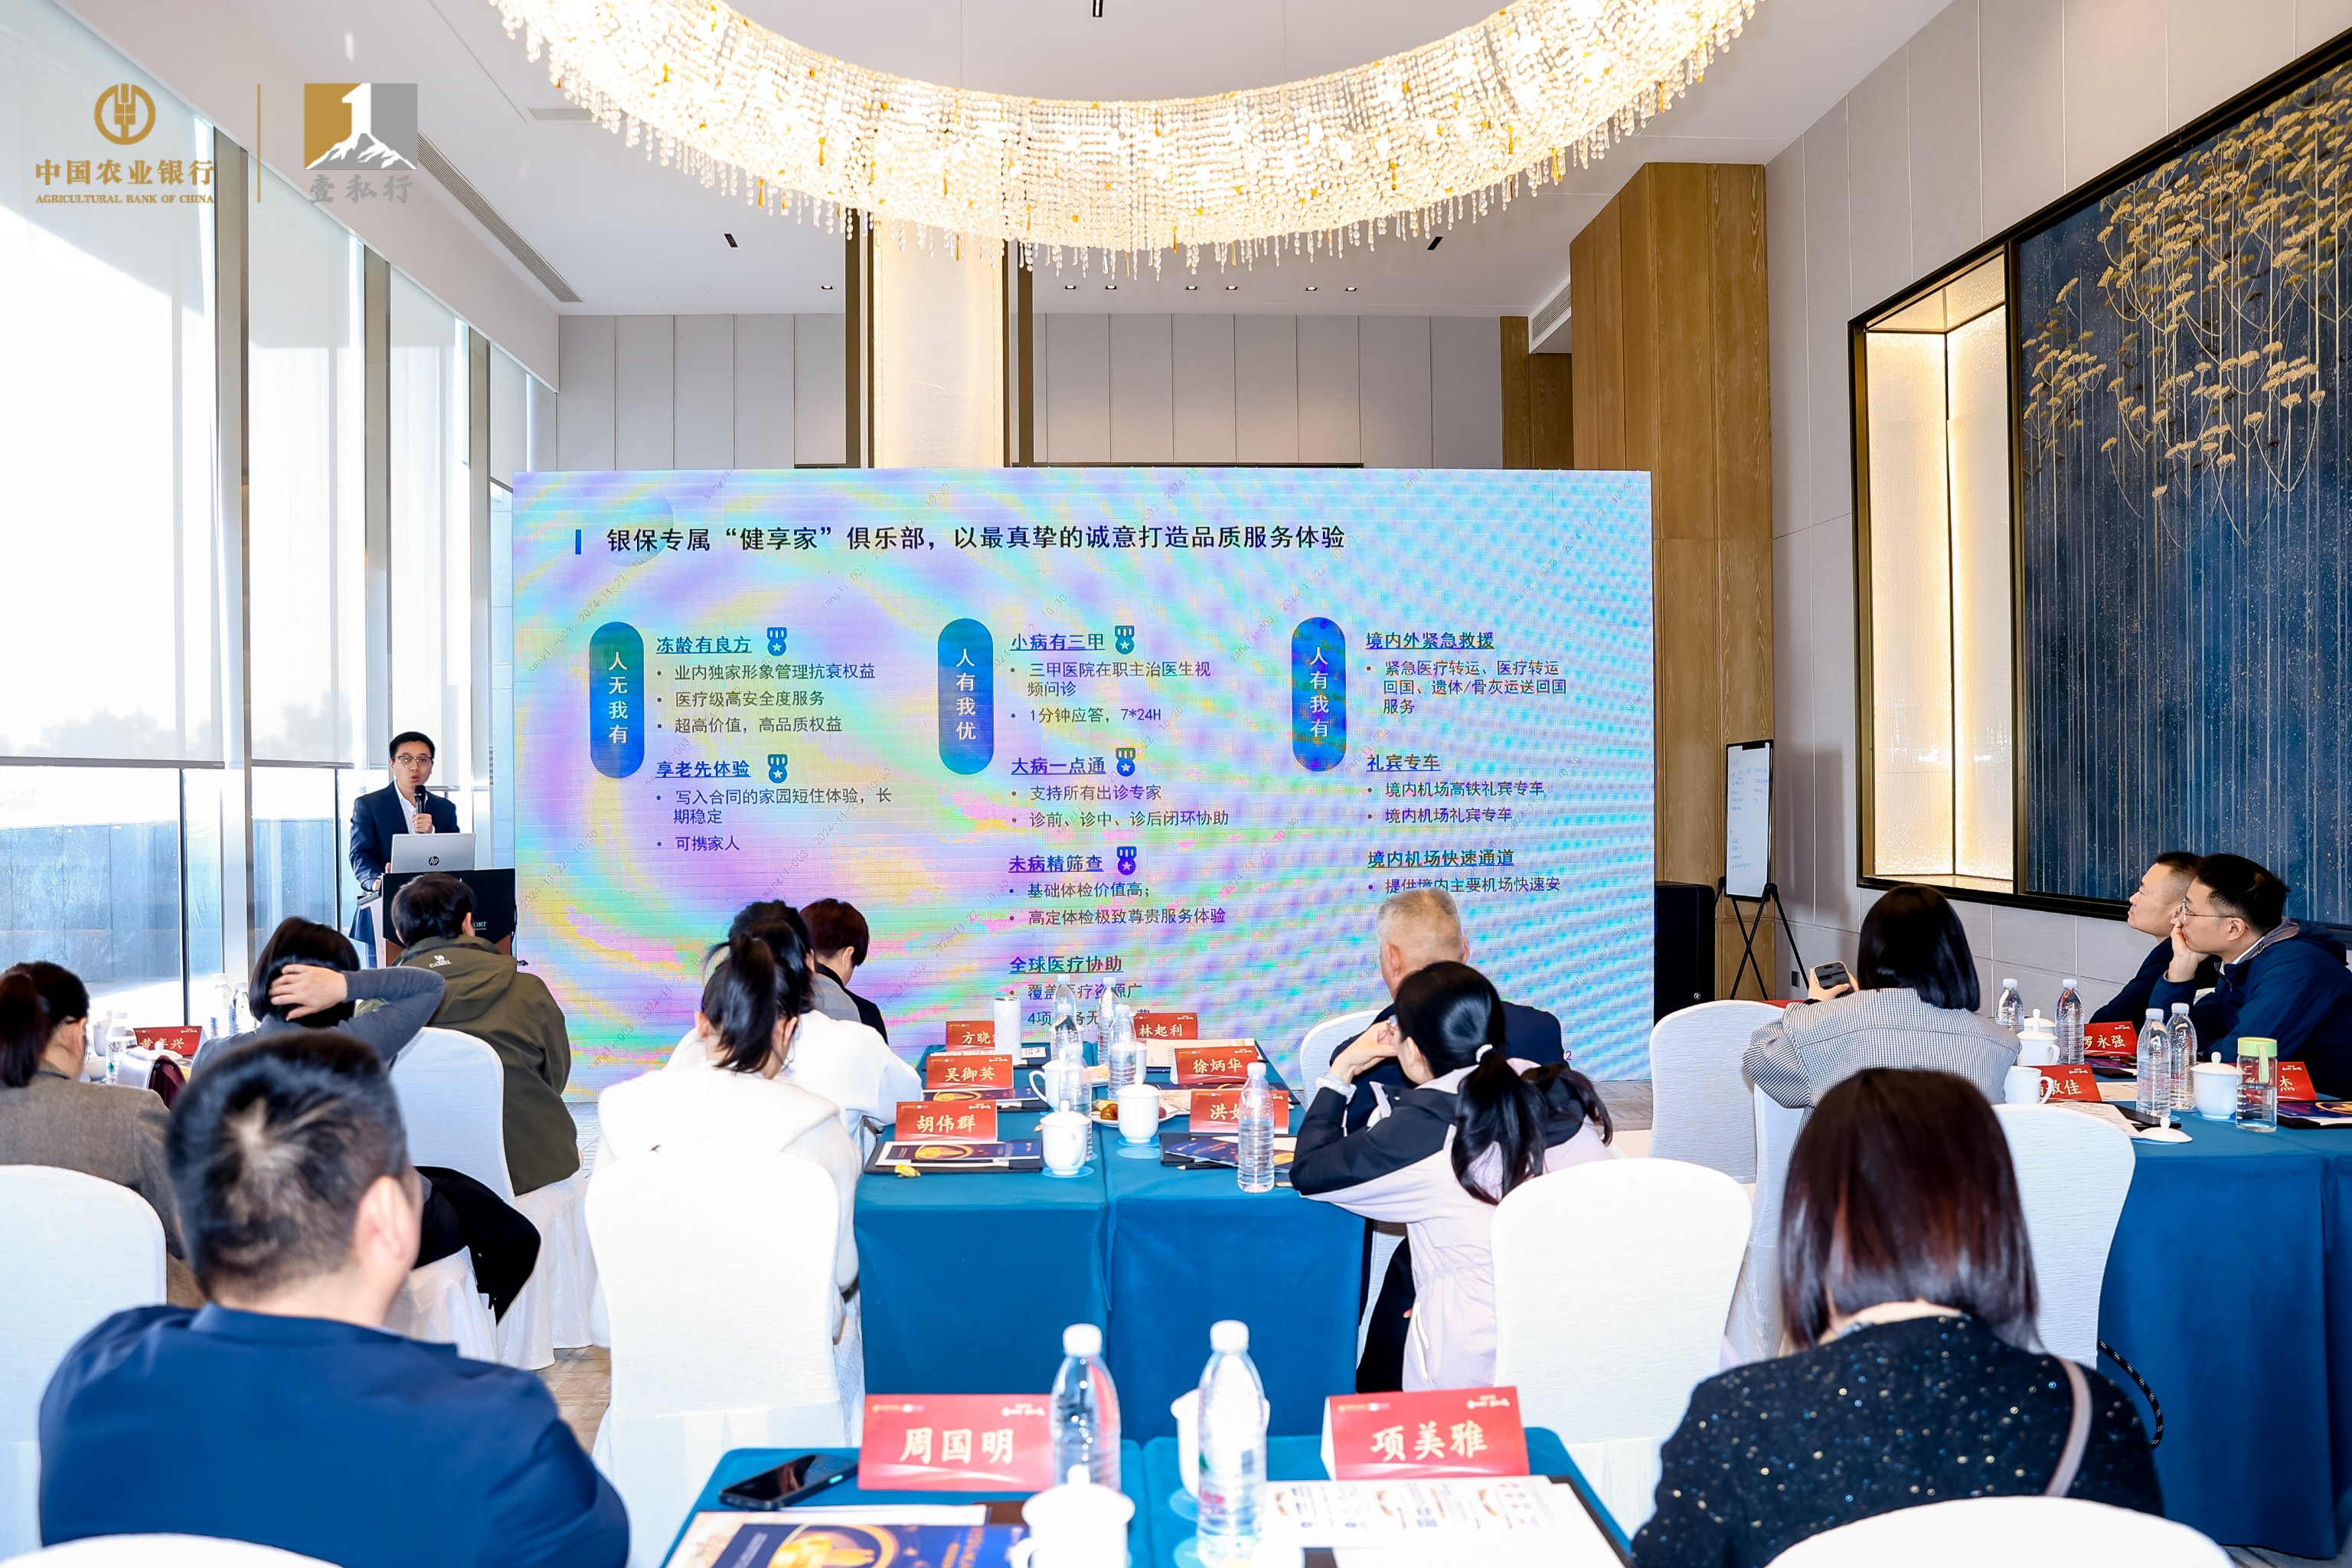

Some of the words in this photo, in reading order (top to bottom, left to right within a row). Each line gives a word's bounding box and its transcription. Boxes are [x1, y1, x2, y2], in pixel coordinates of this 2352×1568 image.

[656, 635, 751, 653] 冻龄有良方
[1011, 633, 1105, 650] 小病有三甲
[1366, 632, 1494, 649] 境内外紧急救援
[675, 663, 876, 681] 业内独家形象管理抗衰权益
[1029, 662, 1211, 678] 三甲医院在职主治医生视
[1386, 660, 1560, 676] 紧急医疗转运、医疗转运
[956, 648, 976, 740] 人有我优
[1027, 681, 1076, 697] 频问诊
[1309, 646, 1329, 738] 人有我有
[1383, 679, 1566, 695] 回国、遗体/骨灰运送回国
[608, 652, 629, 744] 人无我有
[675, 690, 825, 707] 医疗级高安全度服务
[1383, 699, 1415, 714] 服务
[675, 716, 843, 733] 超高价值，高品质权益
[656, 760, 750, 777] 享老先体验
[1011, 756, 1106, 775] 大病一点通
[1367, 753, 1441, 772] 礼宾专车
[675, 787, 892, 805] 写入合同的家园短住体验，长
[1030, 784, 1162, 801] 支持所有出诊专家
[1385, 780, 1544, 797] 境内机场高铁礼宾专车
[673, 808, 723, 825] 期稳定
[1029, 810, 1229, 828] 诊前、诊中、诊后闭环协助
[1385, 807, 1512, 823] 境内机场礼宾专车
[675, 835, 740, 851] 可携家人
[429, 856, 439, 866] hp
[1008, 854, 1104, 873] 未病精筛查
[1367, 849, 1514, 867] 境内机场快速通道
[1028, 907, 1226, 926] 高定体检极致尊贵服务体验
[1009, 956, 1123, 974] 全球医疗协助
[962, 1031, 995, 1044] 方晓
[1138, 1024, 1183, 1037] 林起利
[2082, 1034, 2126, 1049] 罗永强
[1193, 1057, 1243, 1073] 徐炳华
[945, 1066, 995, 1082] 吴御英
[916, 1114, 977, 1133] 胡伟群
[899, 1426, 1014, 1465] 周国明
[1370, 1419, 1488, 1462] 项美雅
